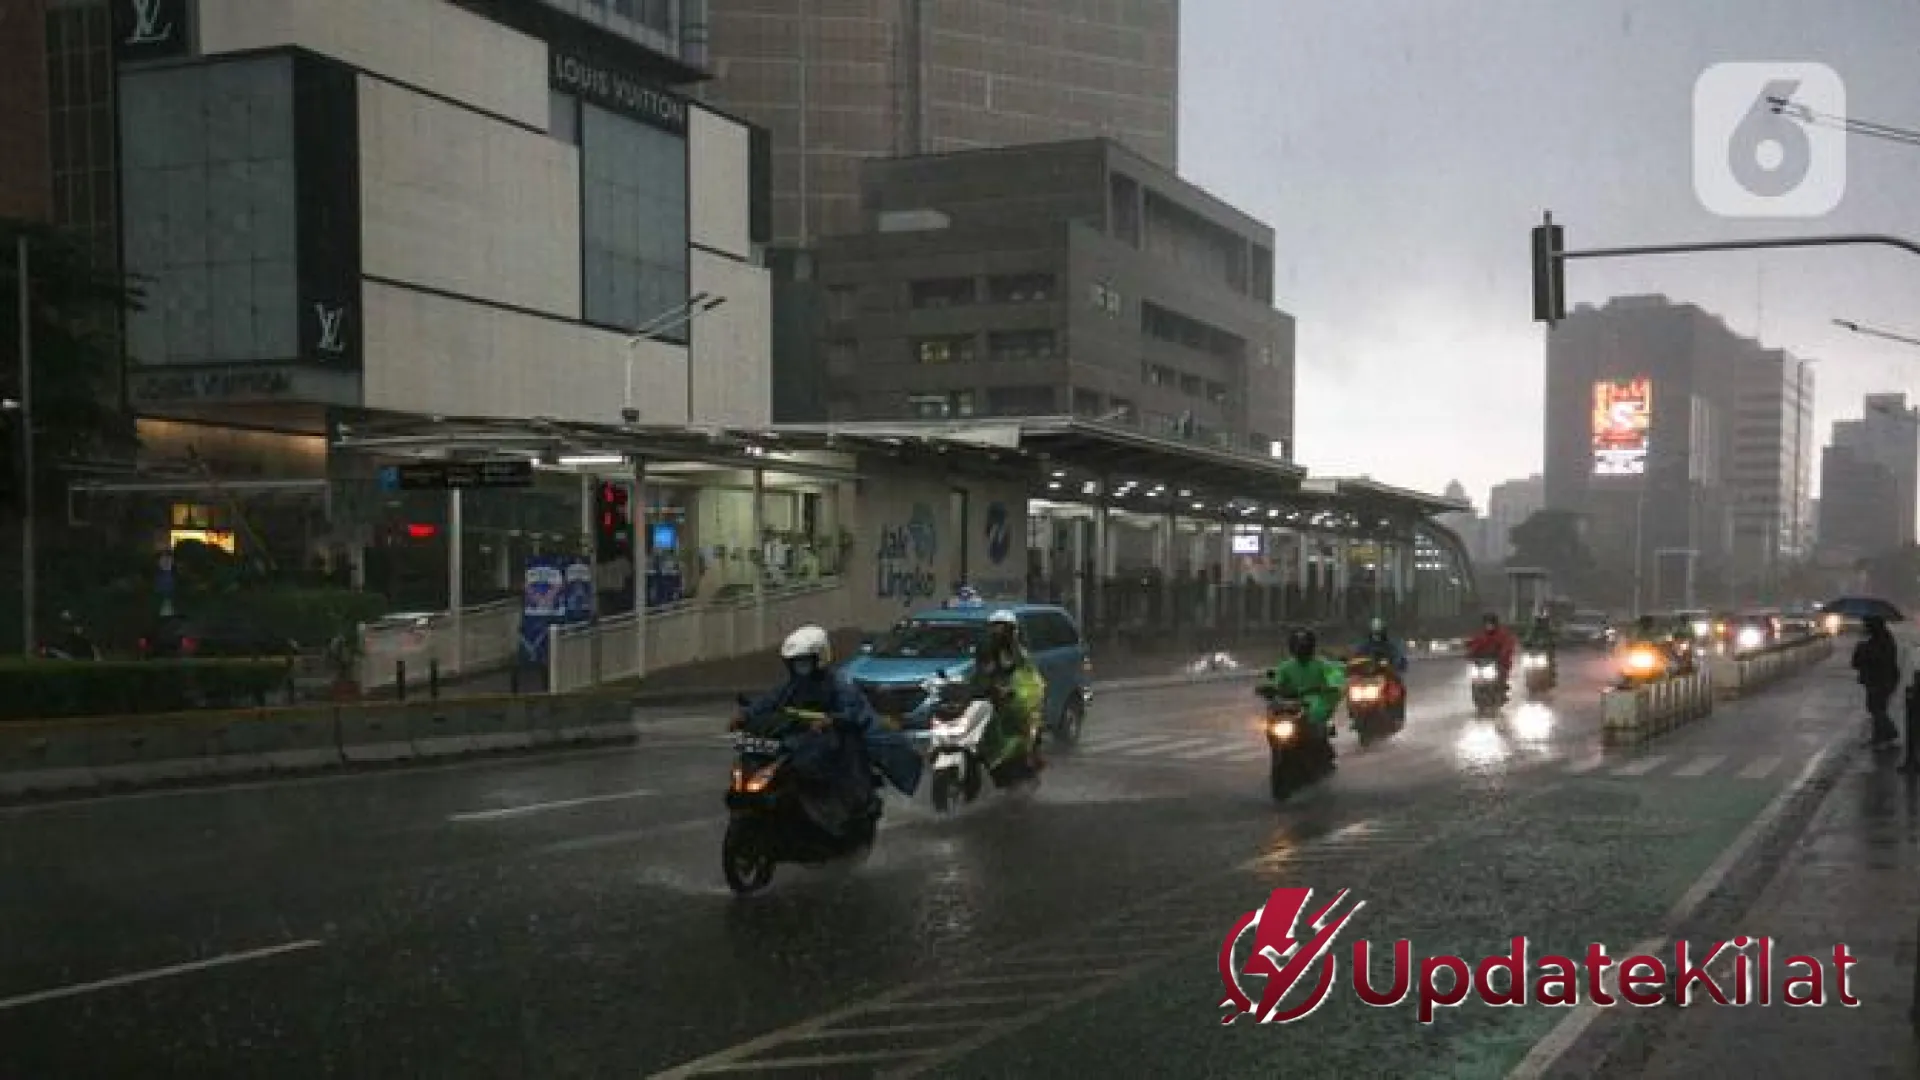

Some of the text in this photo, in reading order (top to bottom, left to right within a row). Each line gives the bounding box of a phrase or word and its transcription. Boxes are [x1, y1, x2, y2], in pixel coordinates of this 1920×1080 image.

[555, 53, 608, 95] LOUIS
[878, 522, 908, 559] Jak
[878, 560, 936, 608] Lingko
